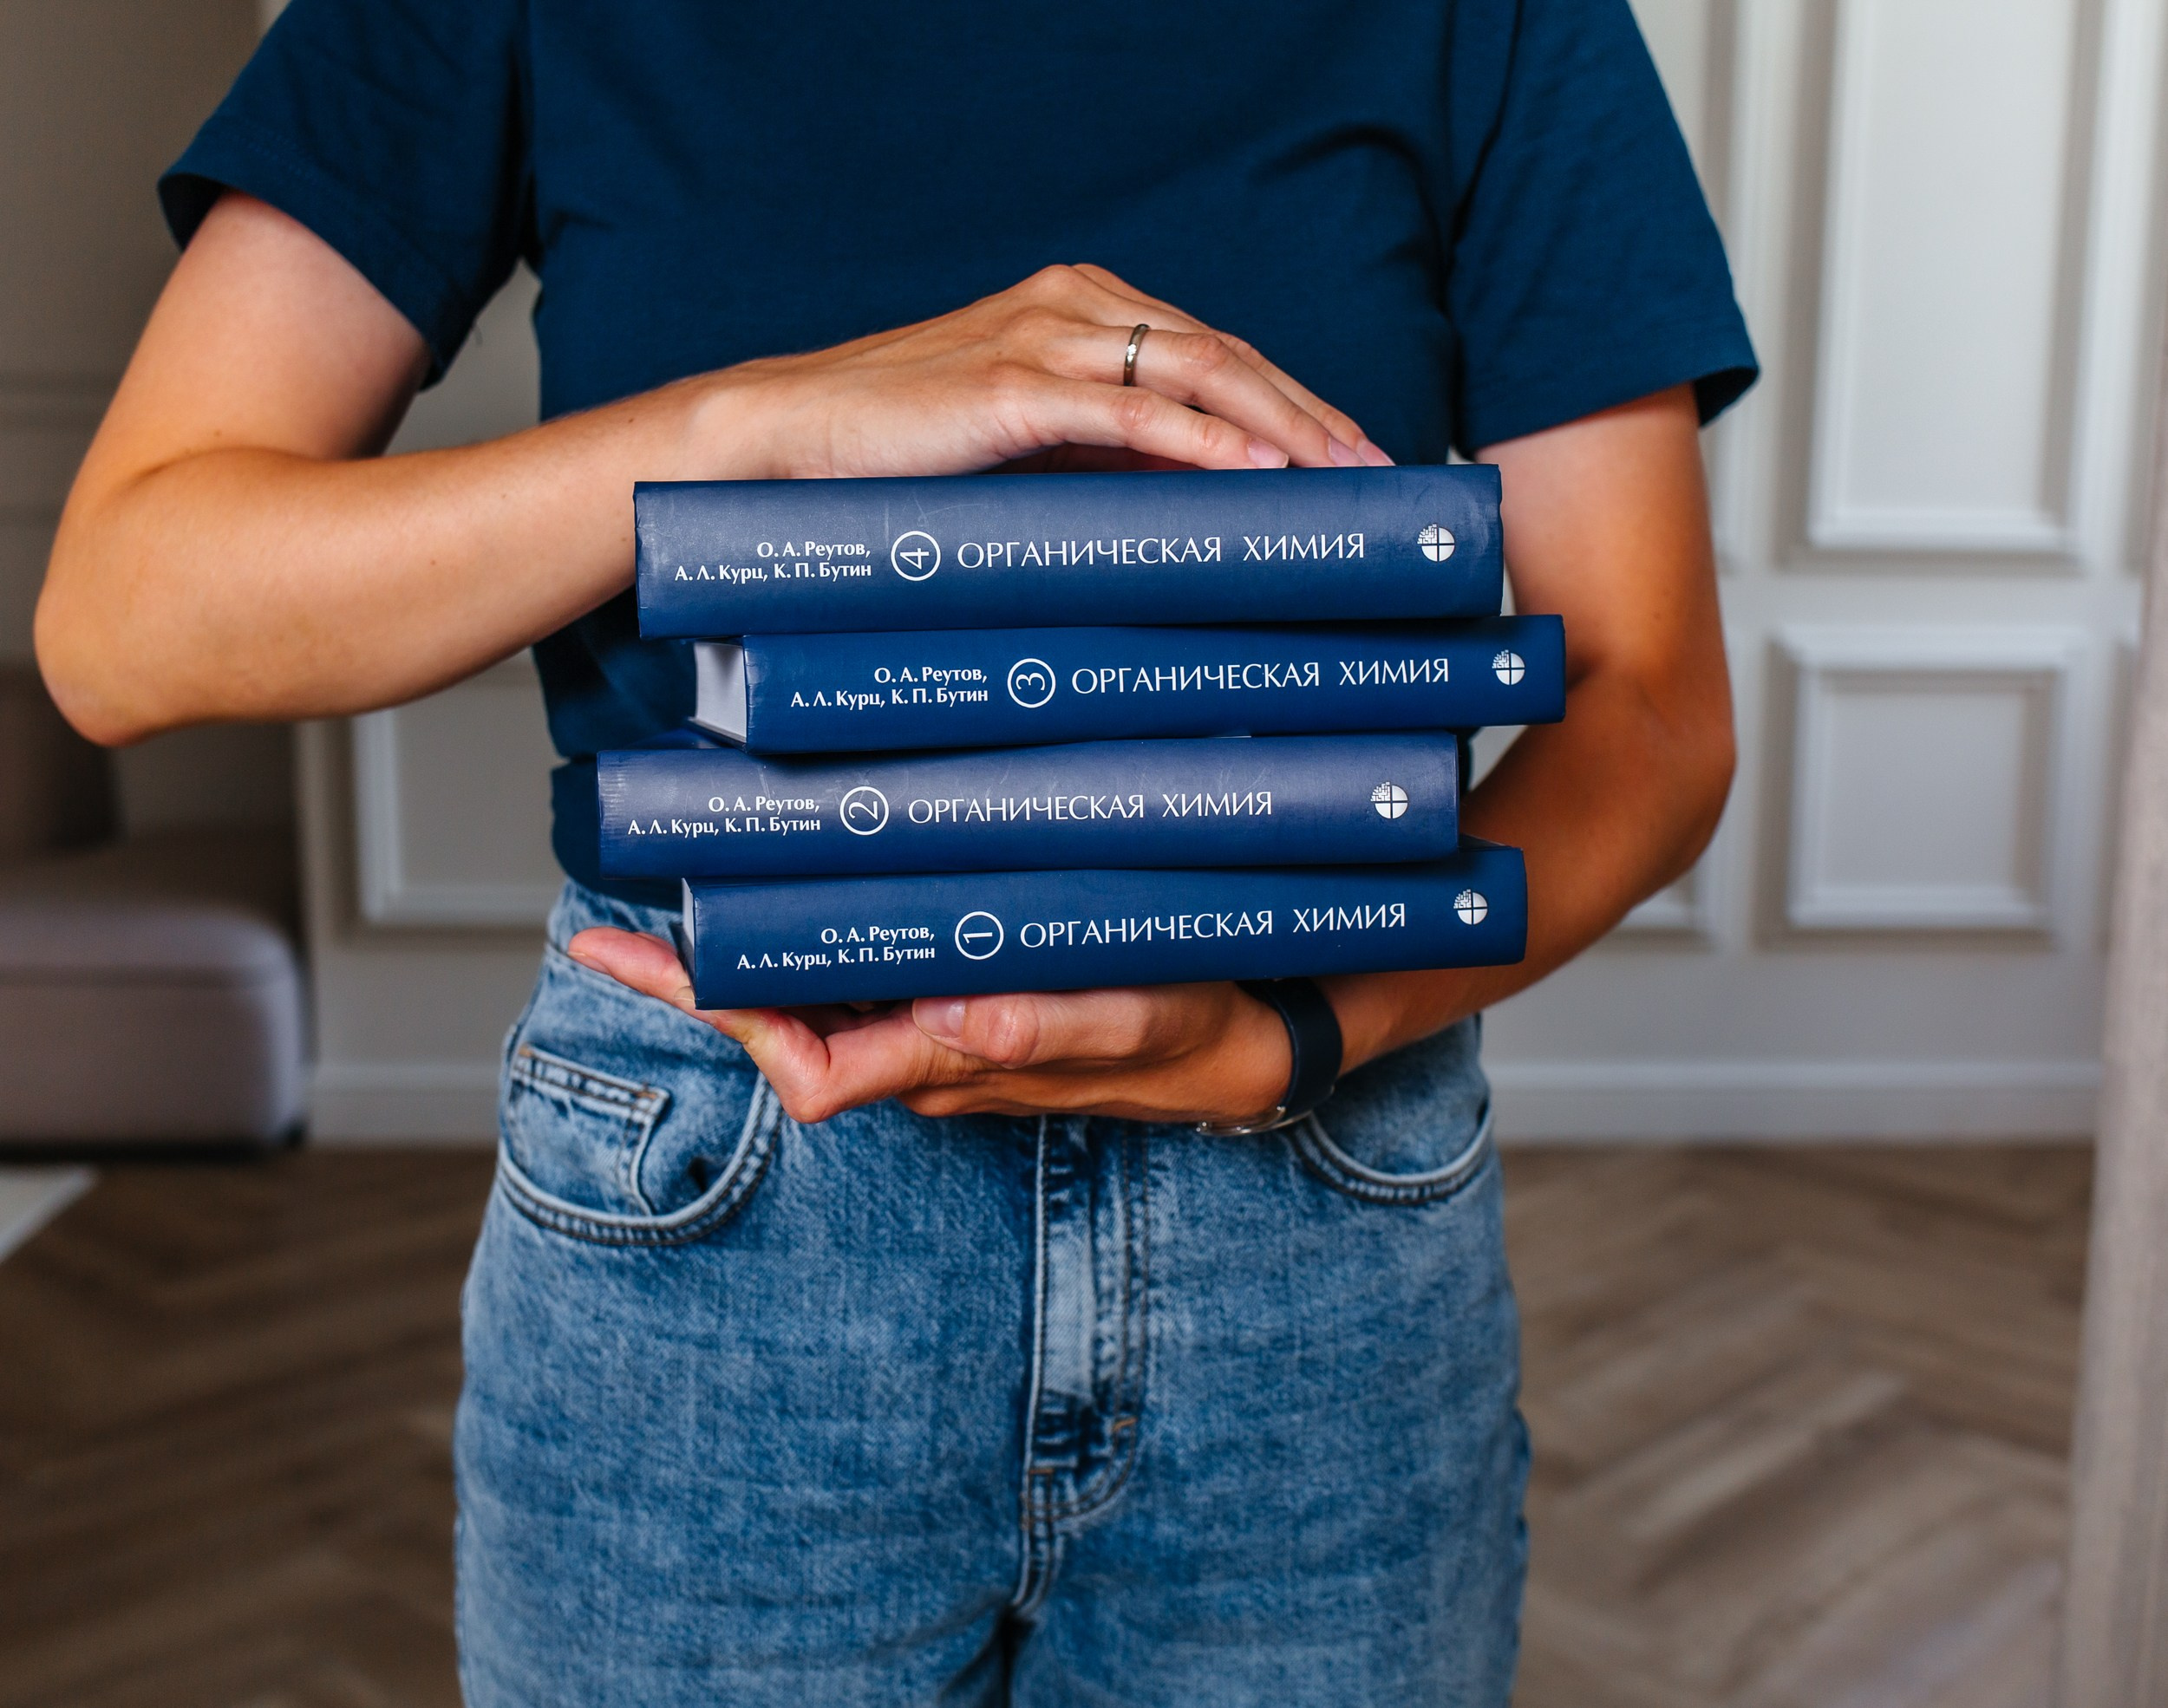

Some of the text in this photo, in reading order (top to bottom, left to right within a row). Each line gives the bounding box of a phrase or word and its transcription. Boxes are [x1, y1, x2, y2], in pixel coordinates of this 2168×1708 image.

[804, 540, 871, 561] Реутов,
[957, 532, 1364, 569] ОРГАНИЧЕСКАЯ ХИМИЯ
[719, 564, 768, 584] Курц,
[819, 562, 872, 583] Бутин
[922, 666, 988, 687] Реутов,
[1072, 658, 1448, 694] ОРГАНИЧЕСКАЯ ХИМИЯ
[836, 690, 885, 711] Курц,
[937, 687, 989, 707] Бутин
[755, 795, 820, 813] Реутов,
[906, 791, 1272, 824] ОРГАНИЧЕСКАЯ ХИМИЯ
[671, 818, 720, 838] Курц,
[769, 816, 820, 836] Бутин
[869, 925, 935, 945] Реутов,
[1020, 903, 1405, 949] ОРГАНИЧЕСКАЯ ХИМИЯ
[782, 951, 832, 971] Курц,
[883, 945, 935, 965] Бутин
